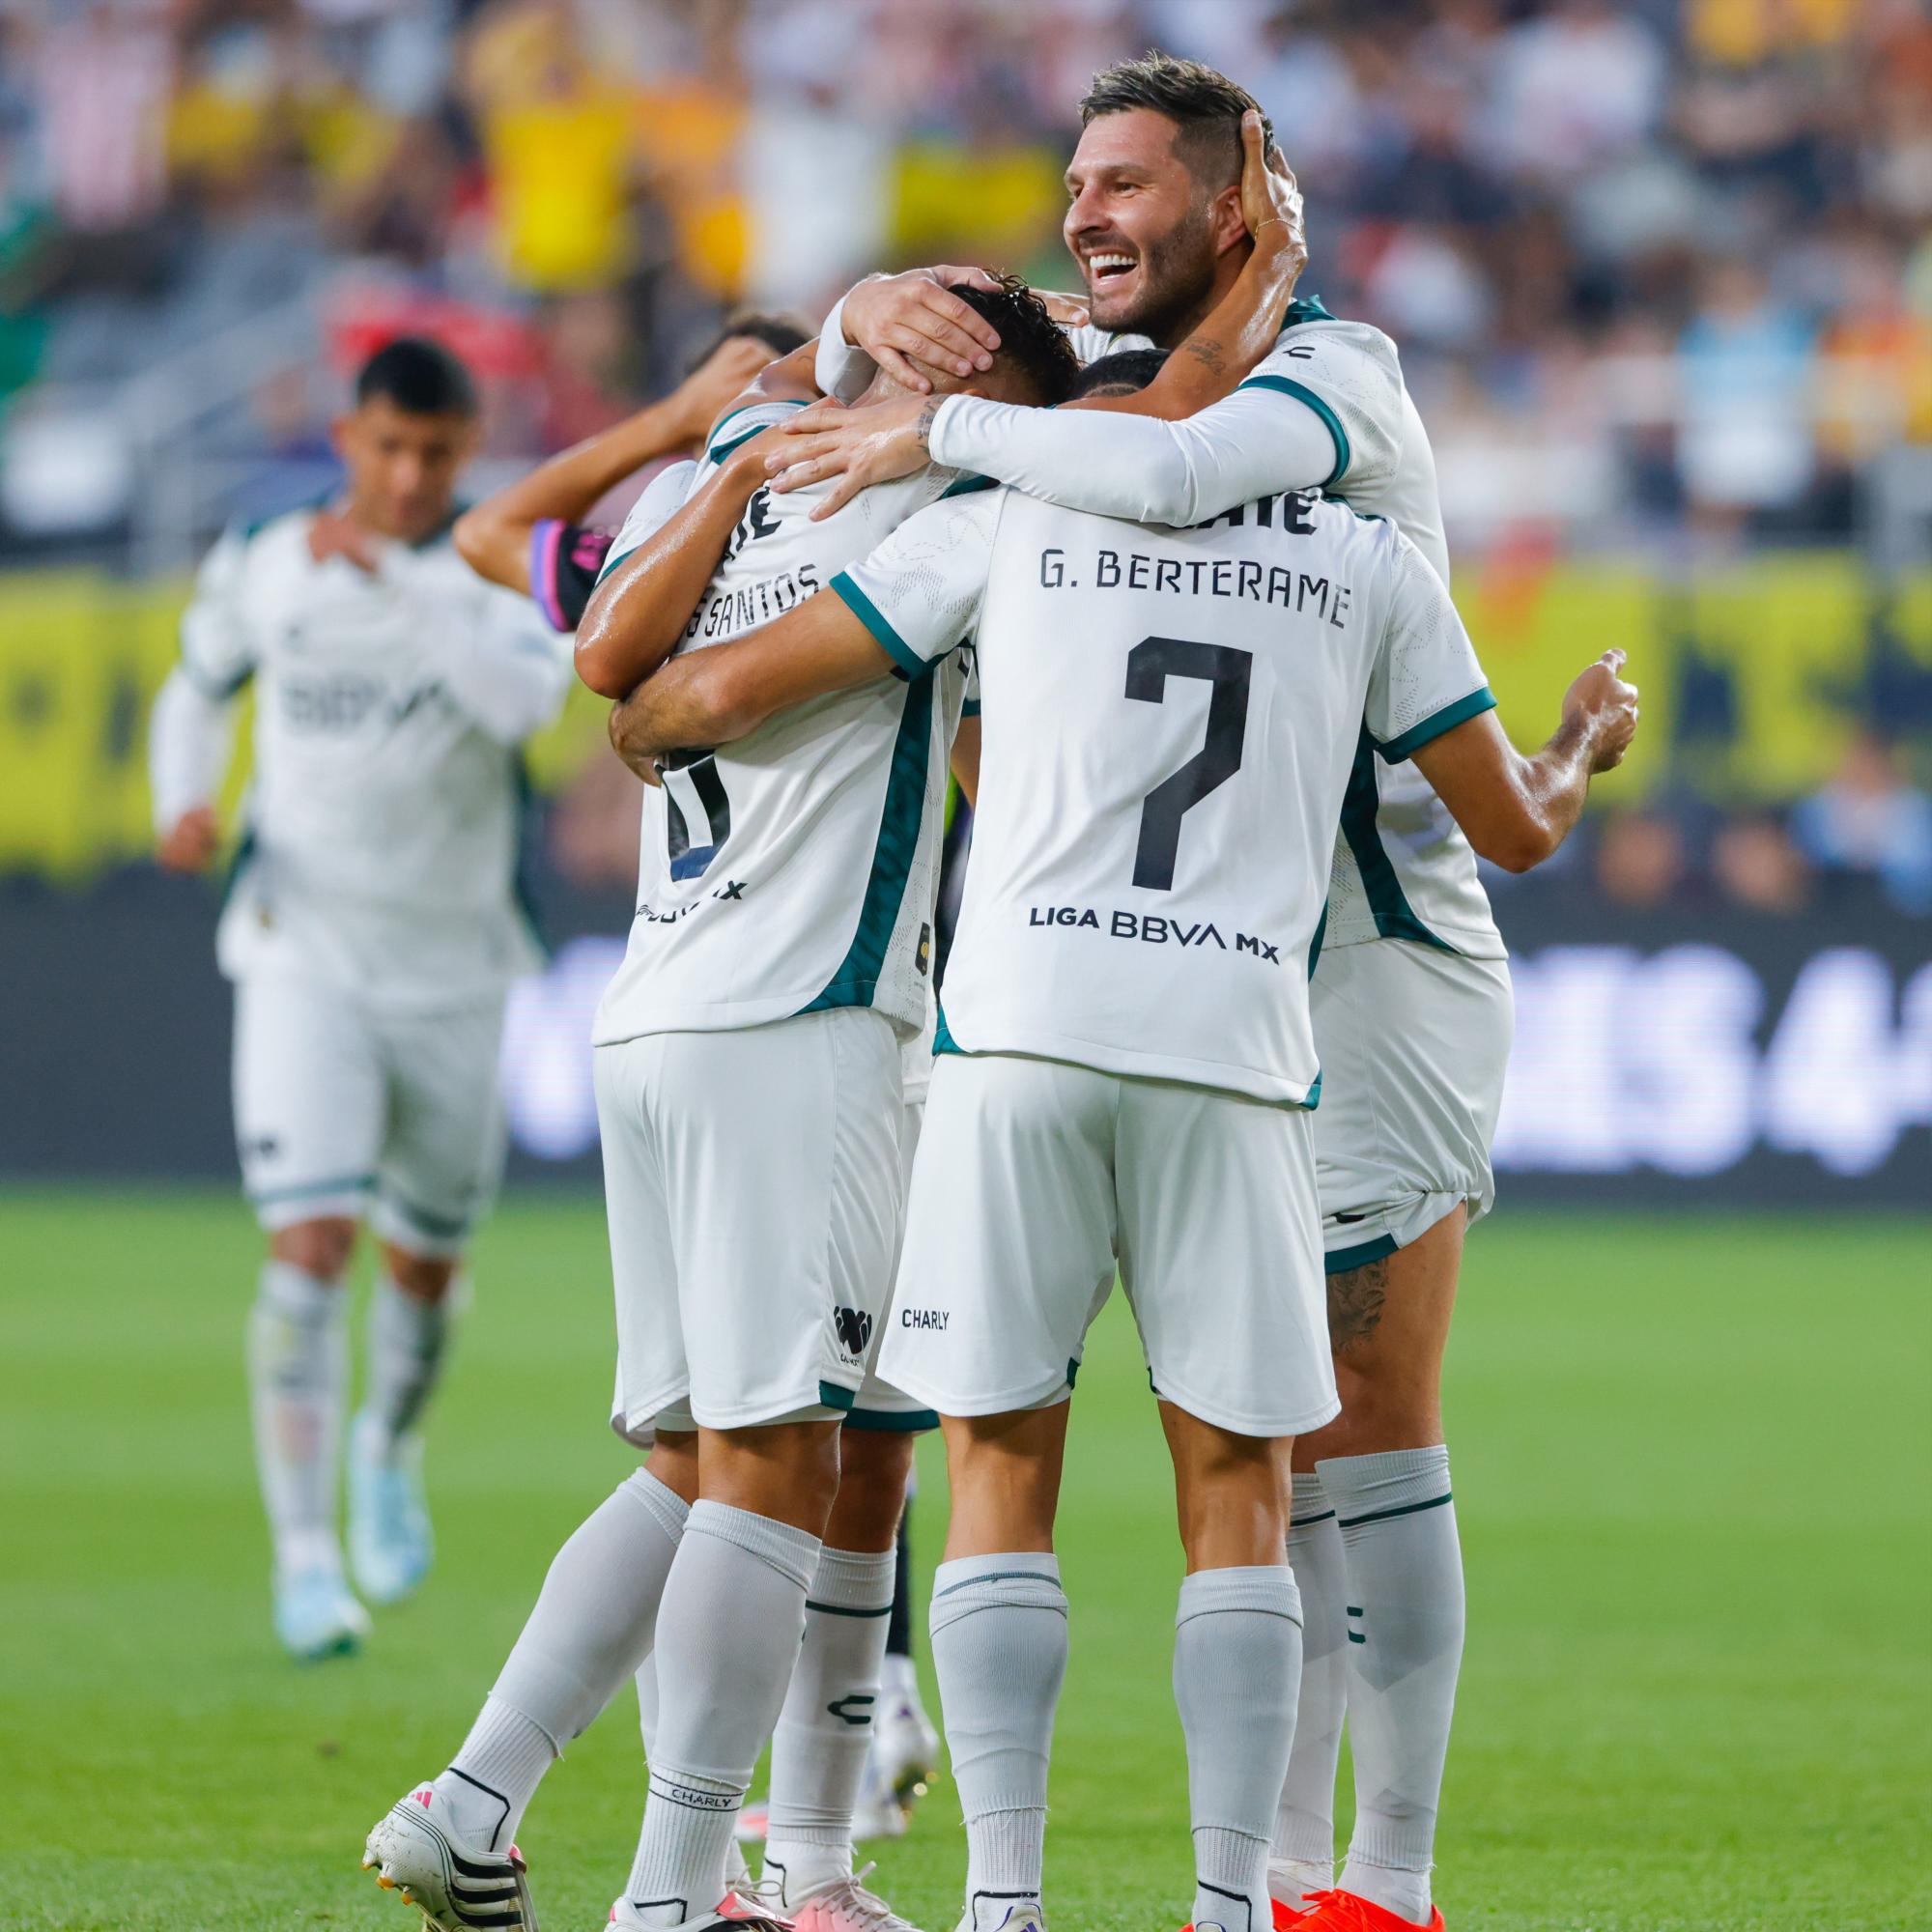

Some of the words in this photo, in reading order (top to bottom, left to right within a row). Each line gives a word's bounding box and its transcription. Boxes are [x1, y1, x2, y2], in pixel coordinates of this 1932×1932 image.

[704, 563, 820, 638] SANTOS
[1040, 549, 1078, 588] G.
[1096, 550, 1351, 630] BERTERAME
[1124, 636, 1253, 892] 7
[1029, 907, 1100, 929] LIGA
[1111, 910, 1227, 951] BBVA
[1236, 932, 1280, 966] MX
[901, 1309, 950, 1331] CHARLY
[671, 1789, 732, 1807] CHARLY
